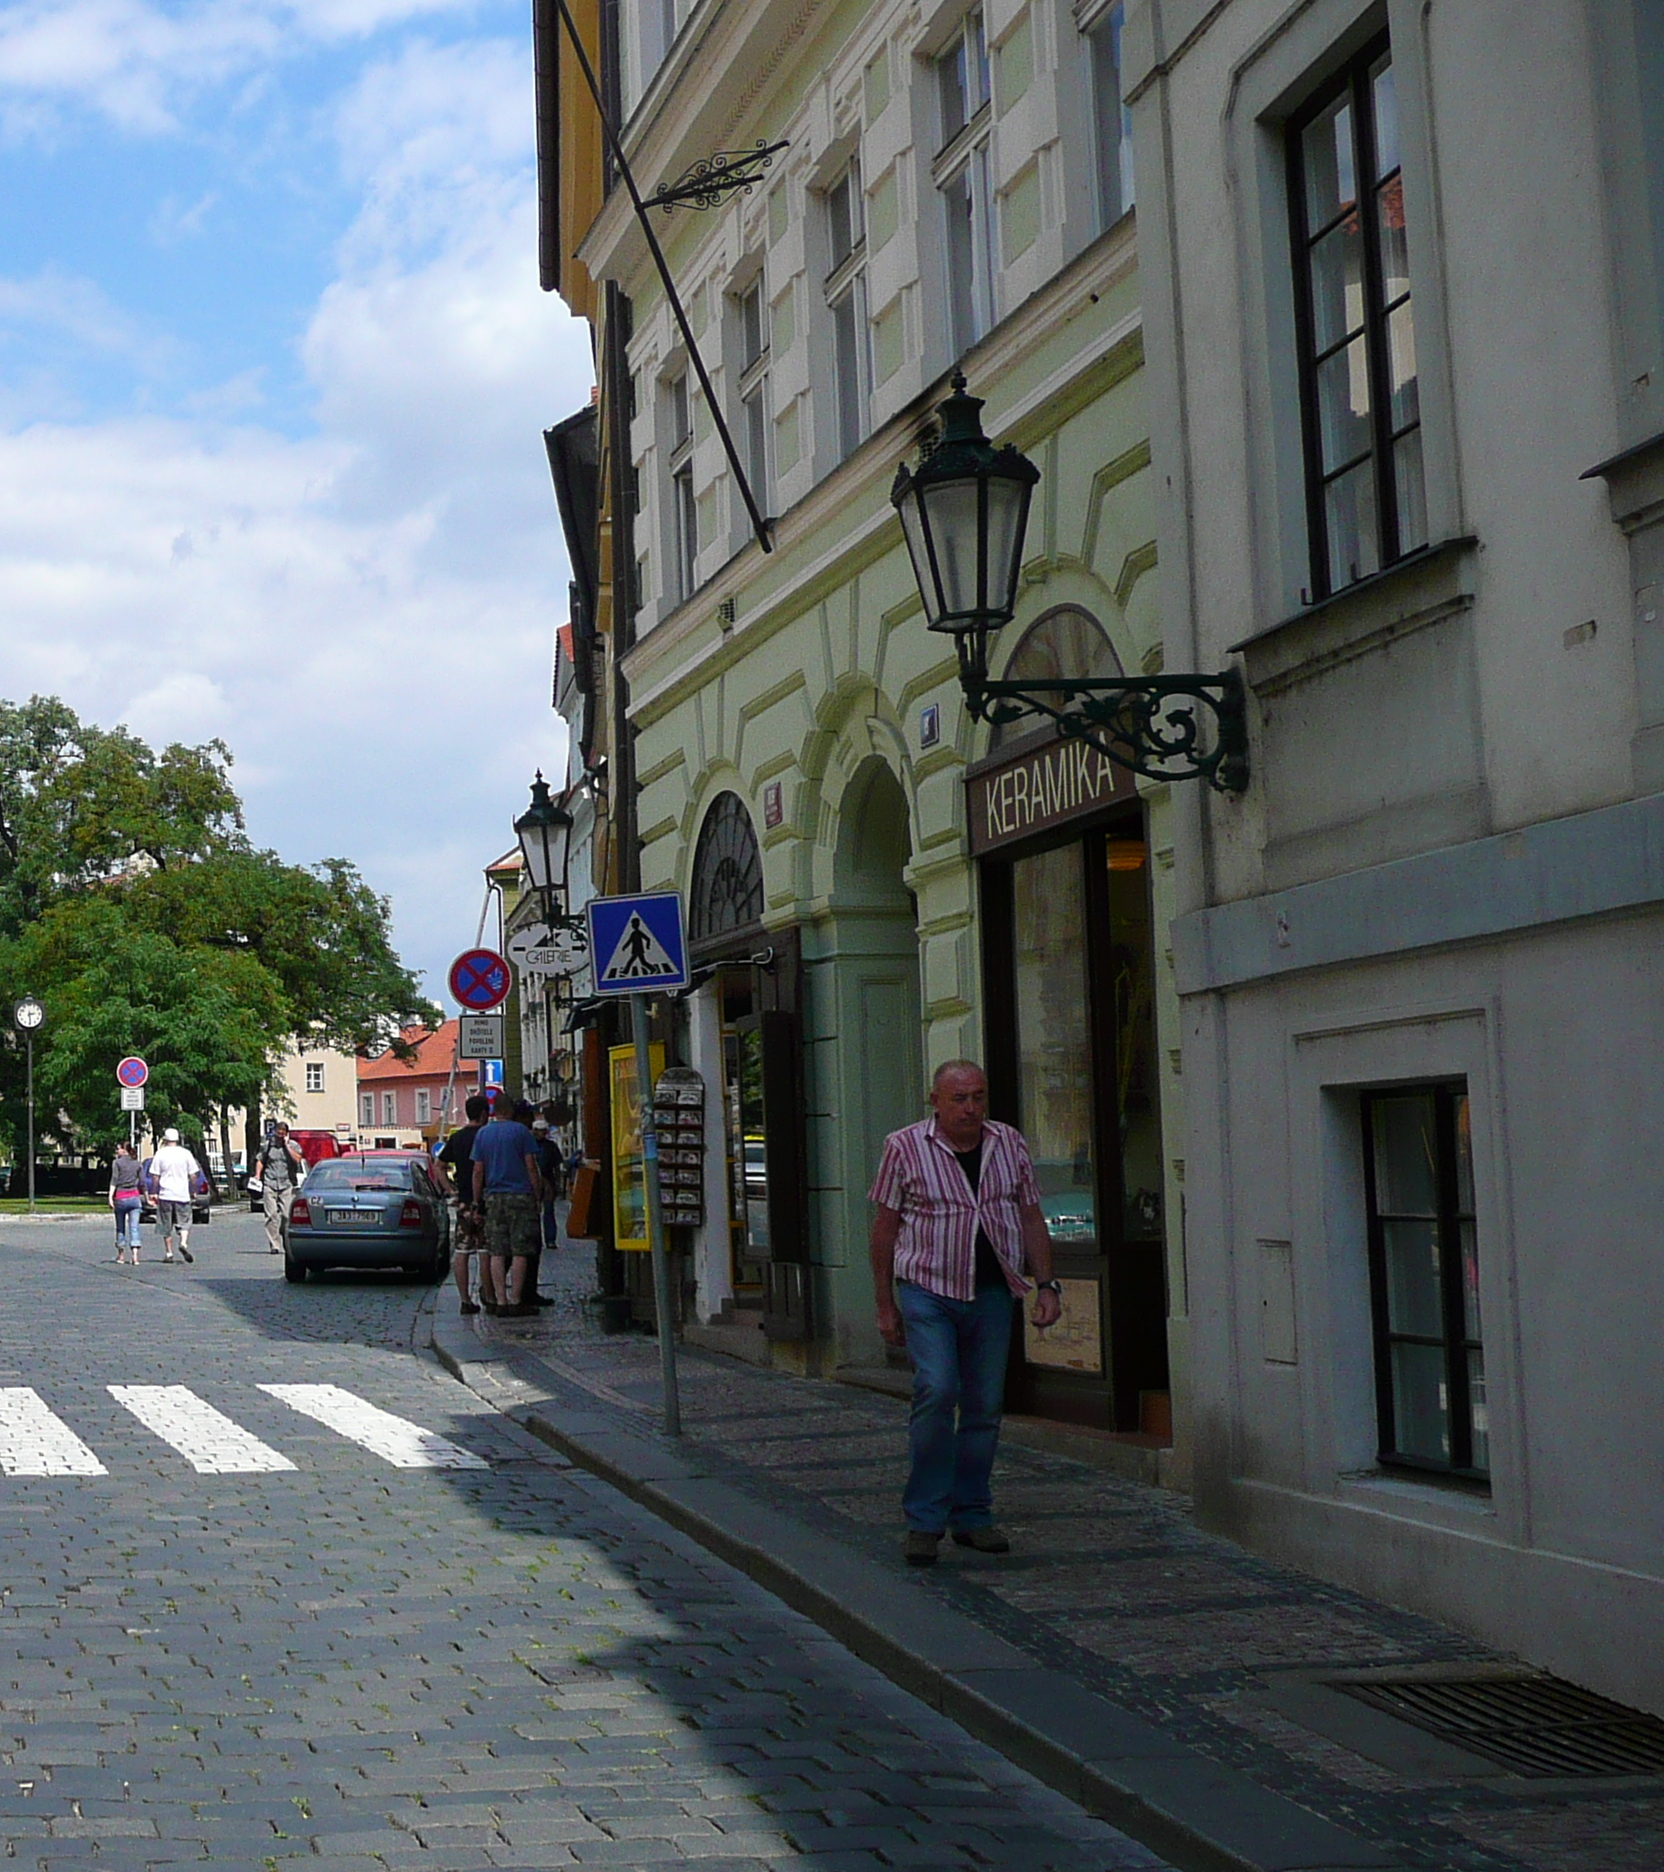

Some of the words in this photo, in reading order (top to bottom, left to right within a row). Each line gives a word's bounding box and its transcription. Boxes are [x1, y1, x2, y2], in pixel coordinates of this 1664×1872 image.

[986, 731, 1115, 839] KERAMIKA
[525, 949, 572, 964] GALERIE
[310, 1196, 321, 1205] CZ
